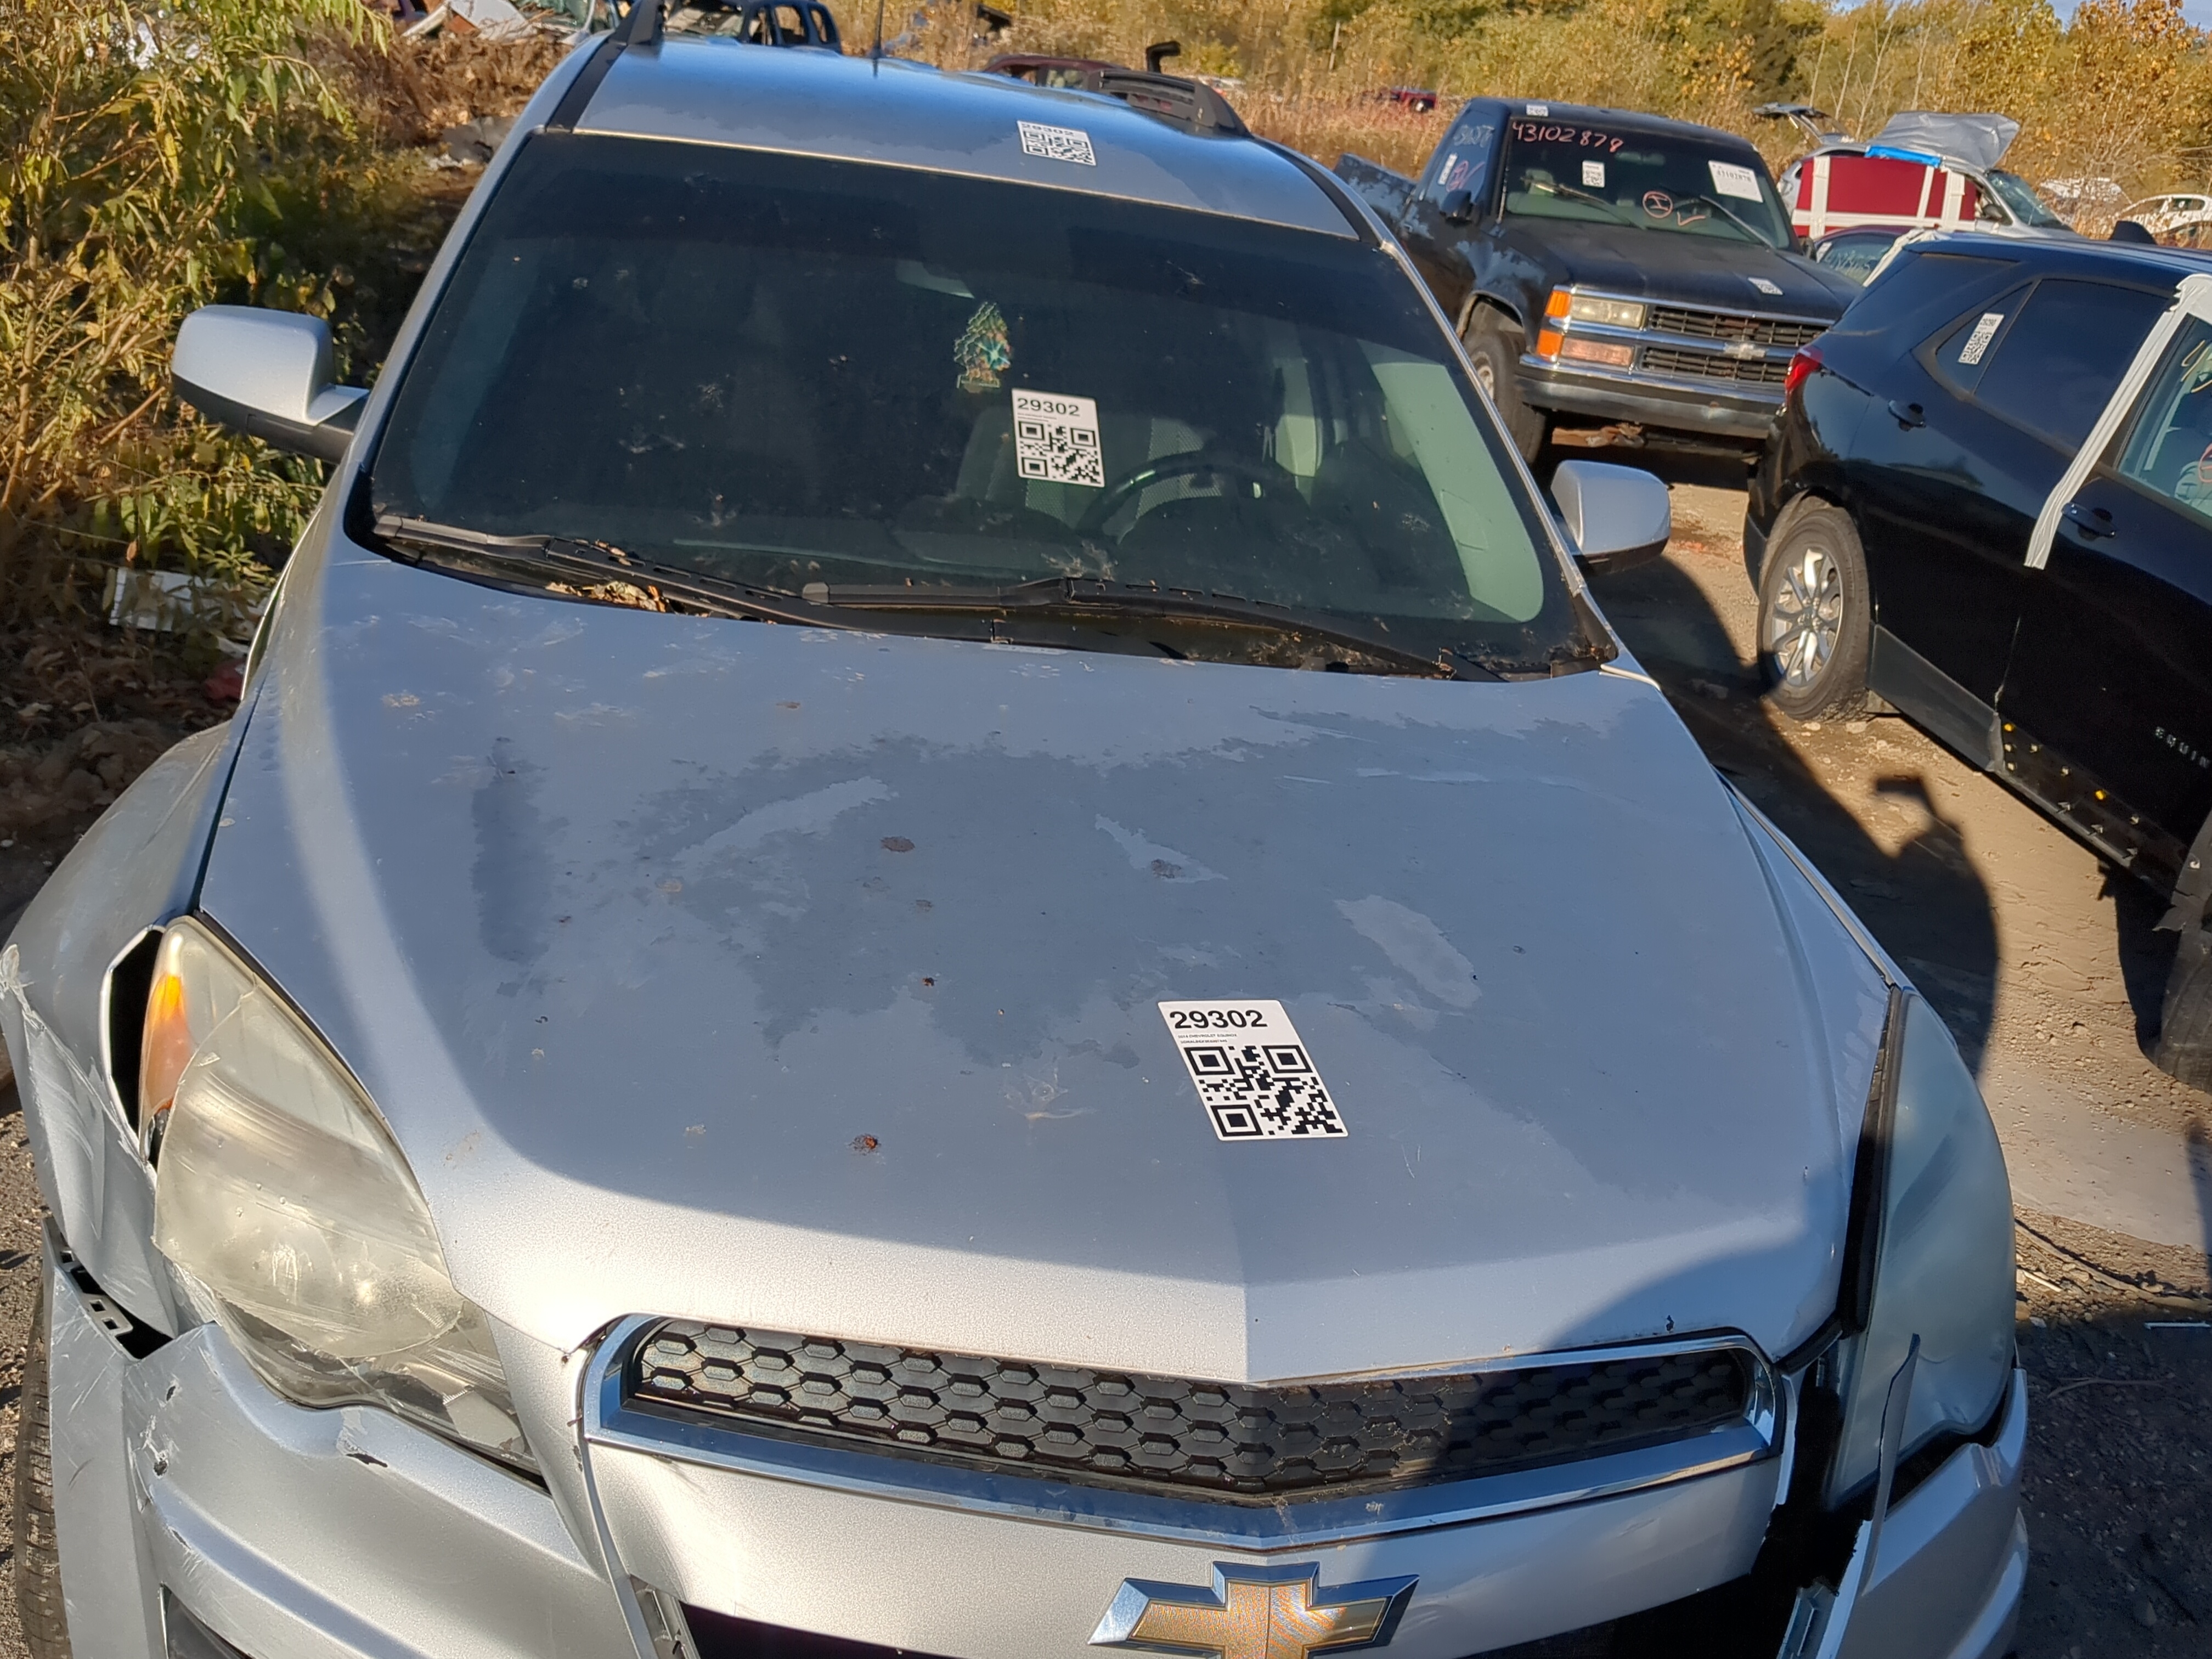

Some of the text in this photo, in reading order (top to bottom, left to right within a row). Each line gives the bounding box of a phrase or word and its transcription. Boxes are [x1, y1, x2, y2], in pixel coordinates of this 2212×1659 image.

[1022, 123, 1074, 136] 29302
[1512, 121, 1624, 153] 43102878
[1017, 398, 1080, 417] 29302
[1169, 1010, 1268, 1029] 29302
